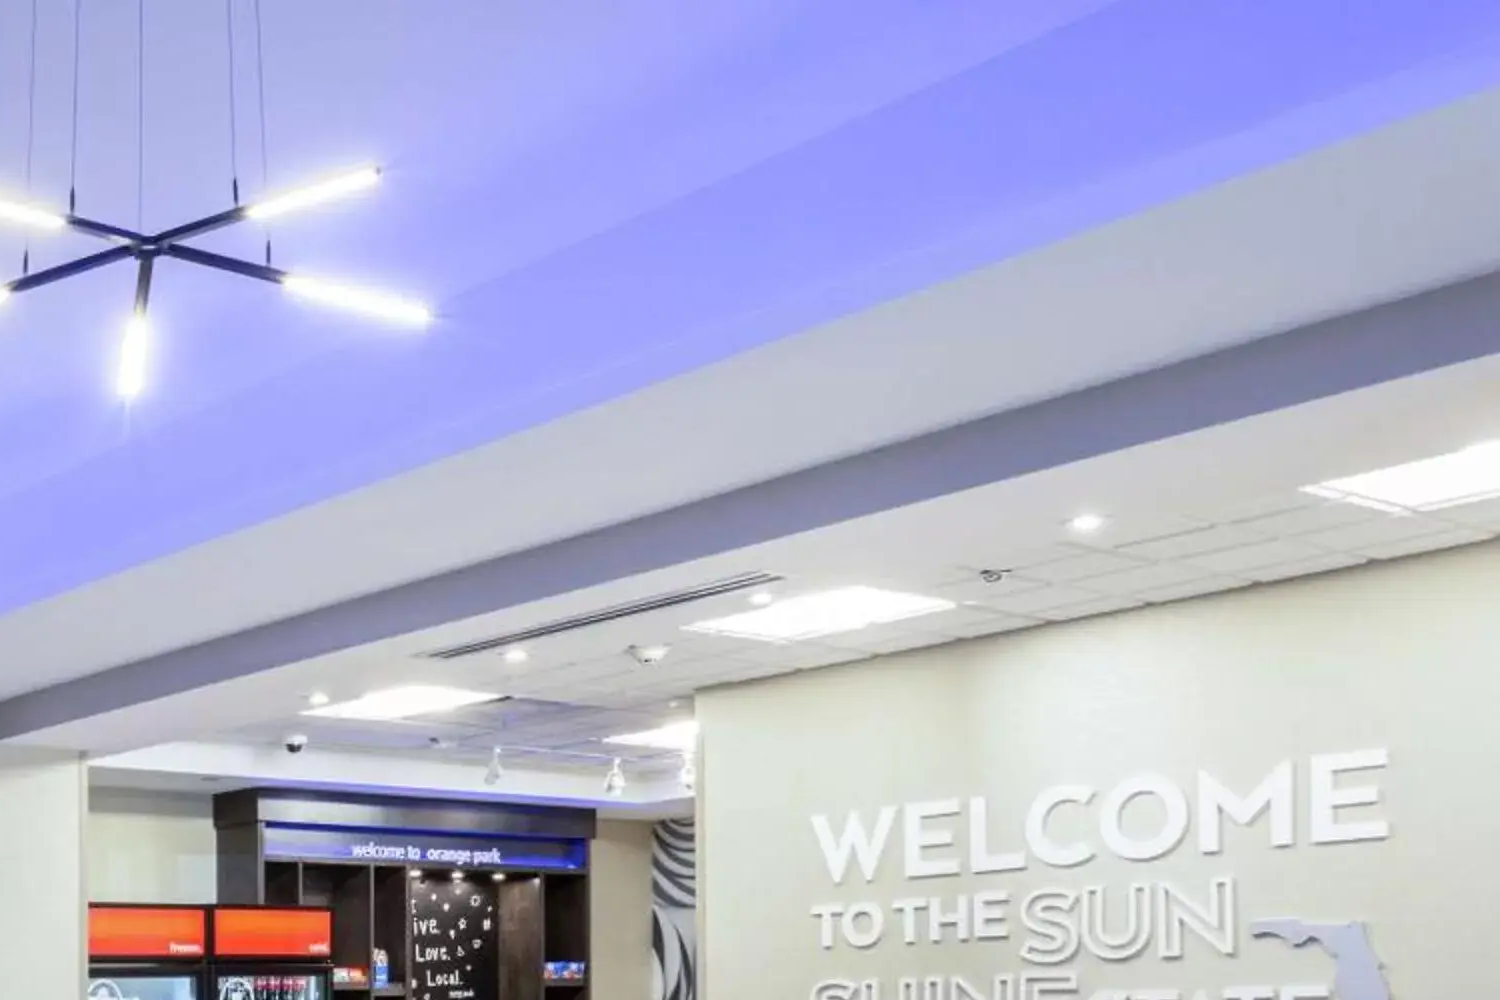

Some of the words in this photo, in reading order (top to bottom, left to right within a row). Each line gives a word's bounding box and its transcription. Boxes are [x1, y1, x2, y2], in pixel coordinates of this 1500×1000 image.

[810, 748, 1390, 884] WELCOME
[351, 841, 405, 859] welcome
[407, 845, 421, 861] to
[427, 848, 471, 865] orange
[473, 847, 501, 866] park
[412, 917, 442, 937] ive.
[809, 902, 885, 950] TO
[892, 890, 1011, 945] THE
[1019, 875, 1236, 966] SUN
